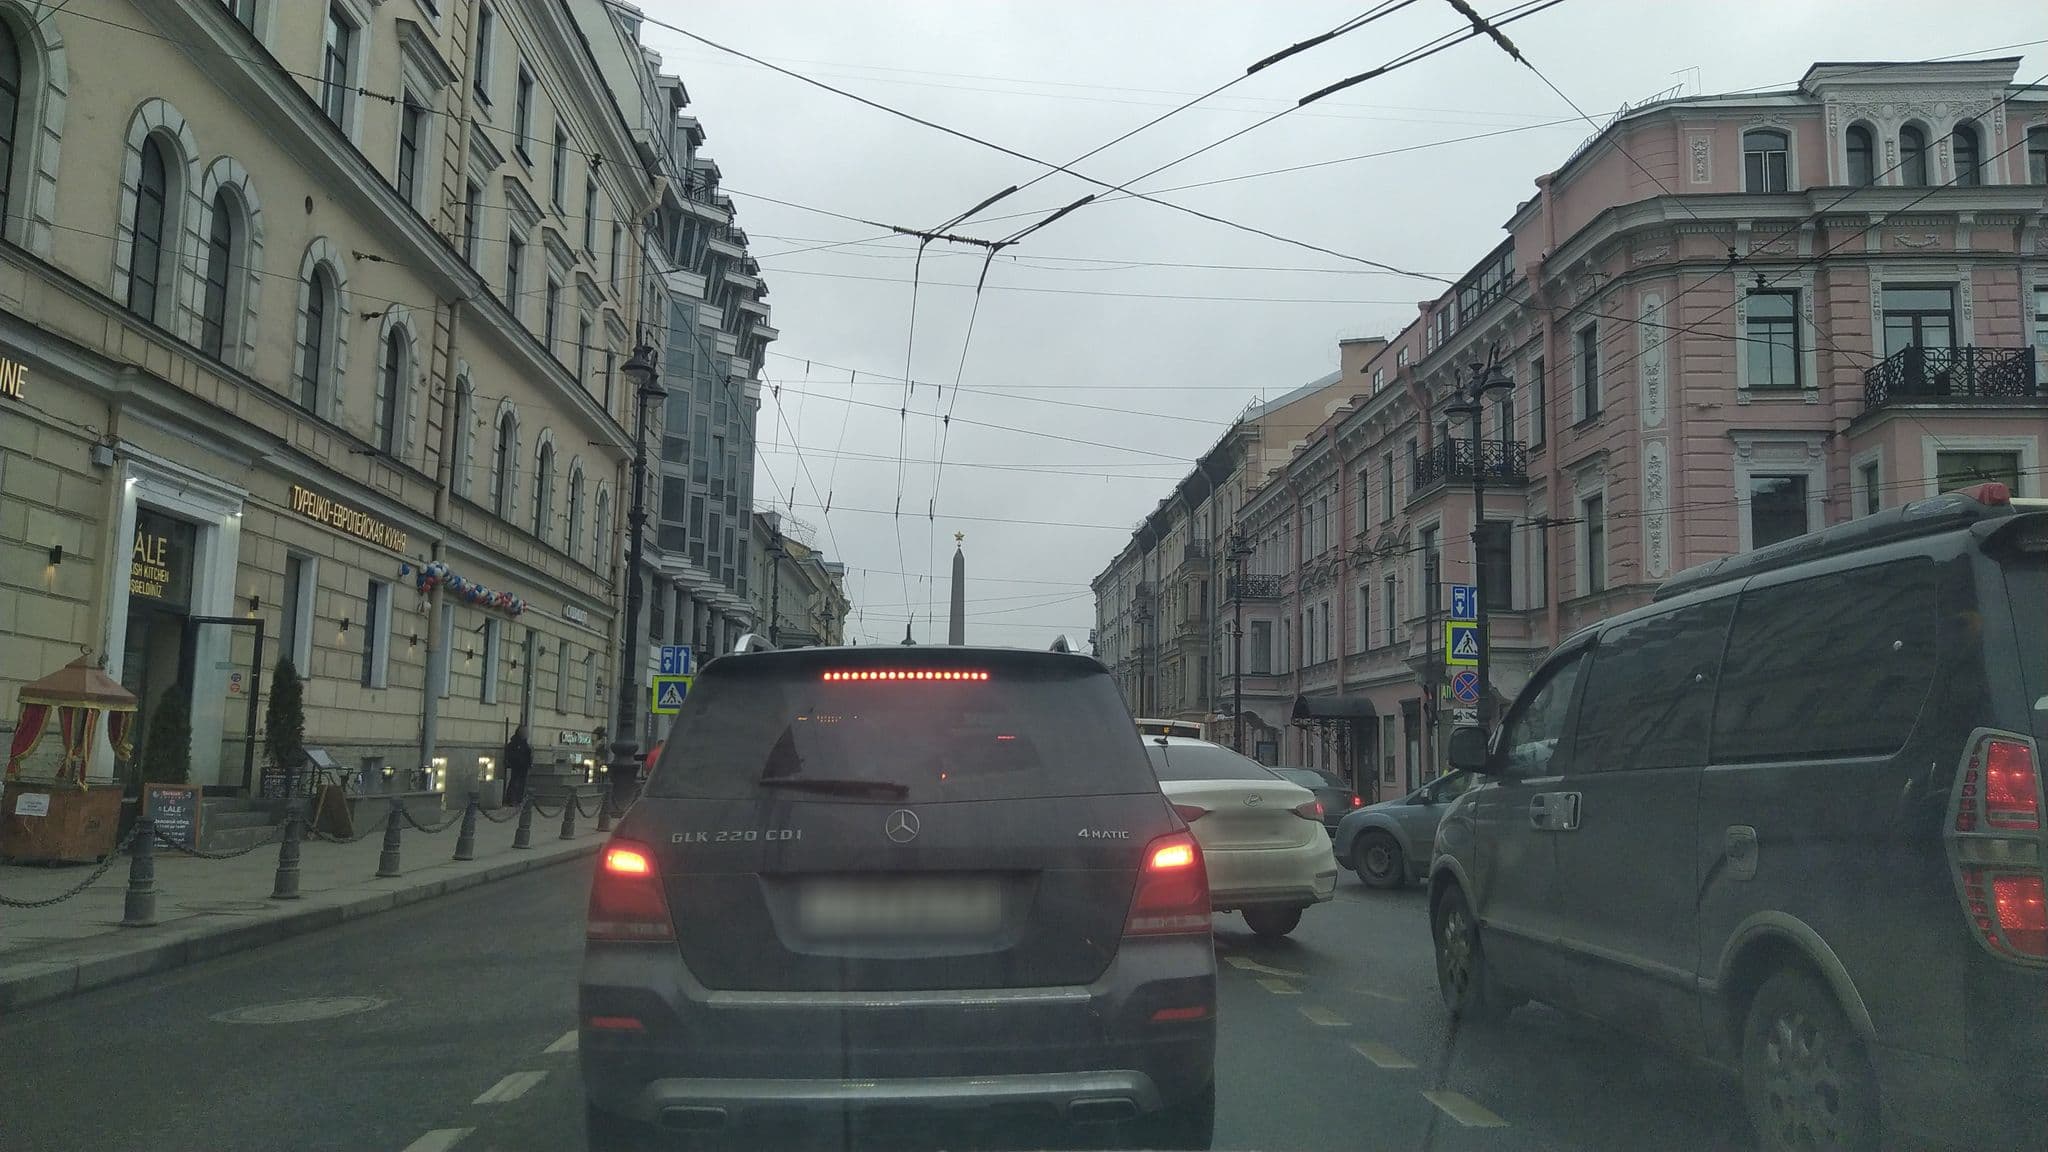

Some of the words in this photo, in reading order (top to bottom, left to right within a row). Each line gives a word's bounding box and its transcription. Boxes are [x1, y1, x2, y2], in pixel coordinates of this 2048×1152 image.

[293, 485, 384, 543] ТУРЕЦКО-ЕВРОПЕЙСКАЯ
[384, 527, 407, 553] КУХНЯ
[131, 562, 143, 577] ISH
[143, 565, 170, 583] KITCHEN
[671, 831, 708, 843] GLK
[715, 830, 758, 842] 220
[765, 829, 802, 841] CDI
[1078, 828, 1129, 839] 4MATIC
